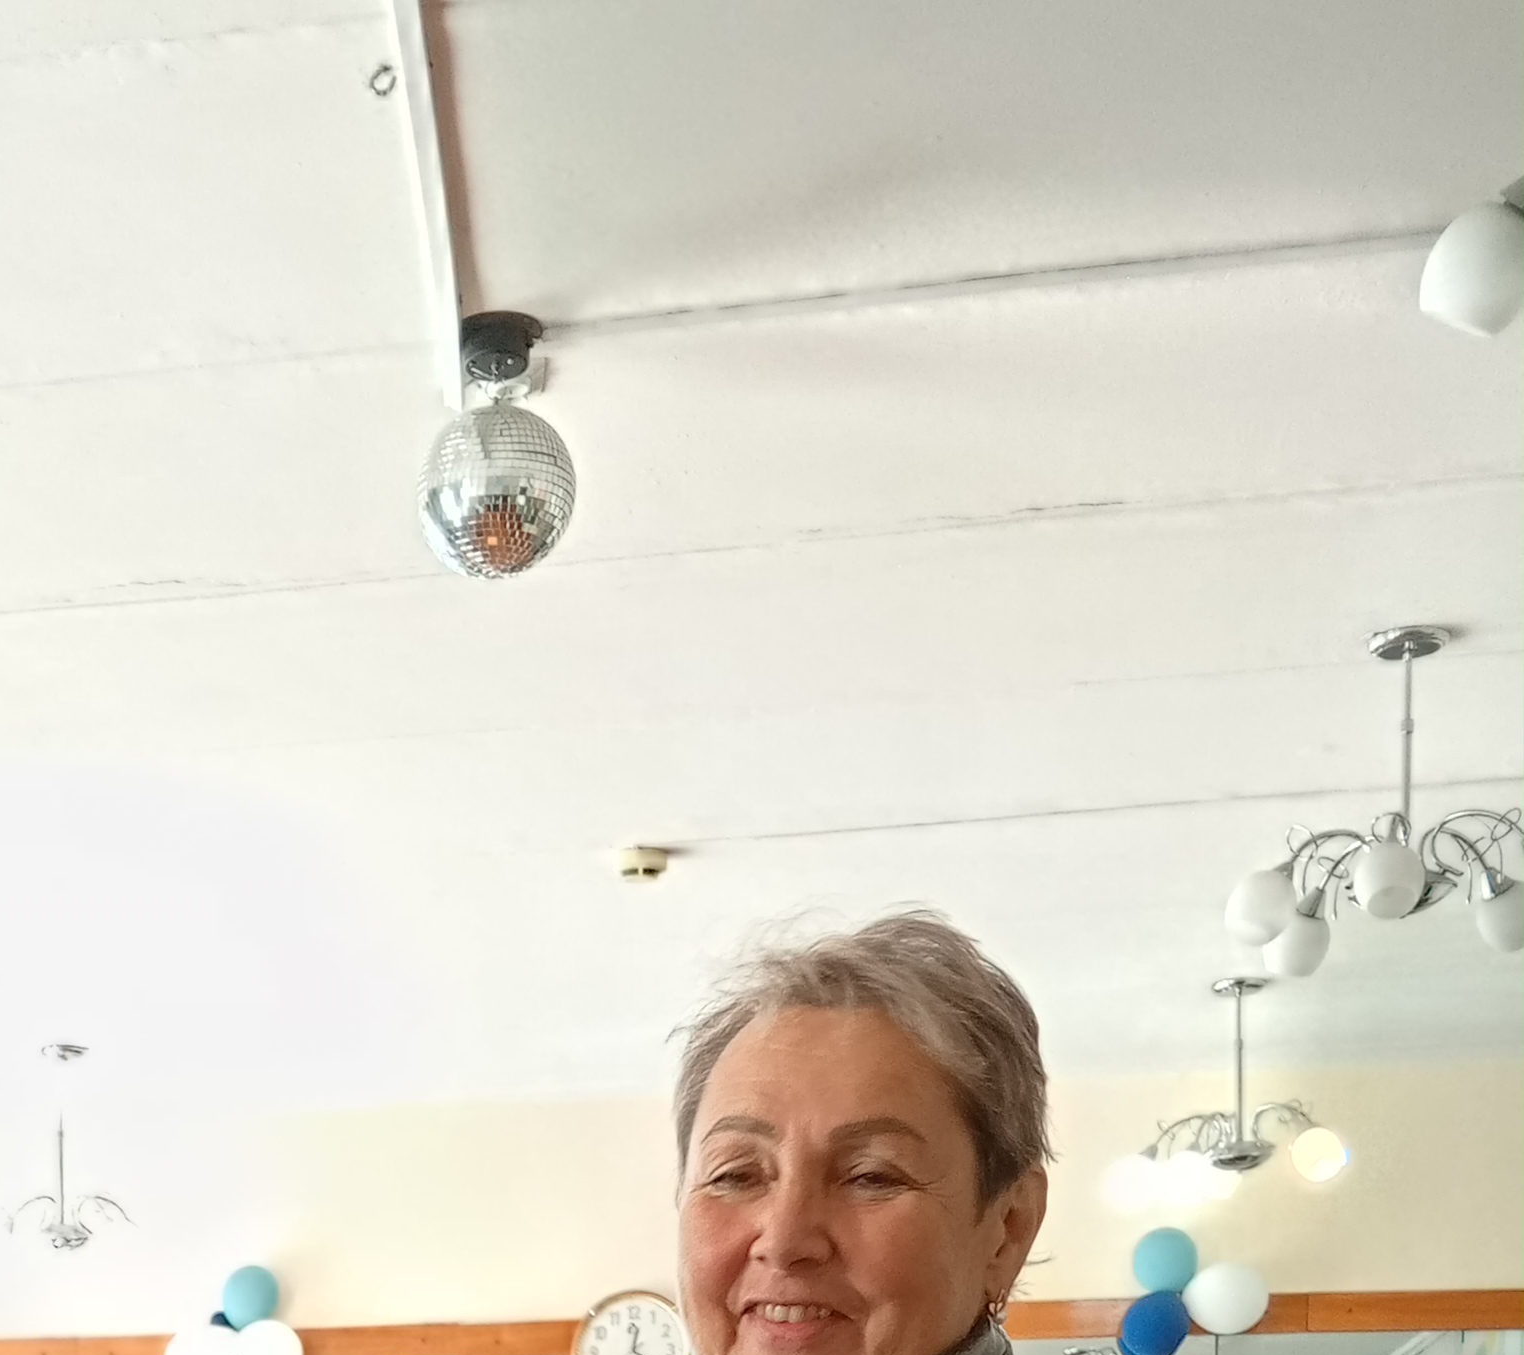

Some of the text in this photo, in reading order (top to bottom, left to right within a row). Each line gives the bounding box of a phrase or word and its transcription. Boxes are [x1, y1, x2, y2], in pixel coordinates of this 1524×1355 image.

[609, 1310, 620, 1326] 11
[627, 1305, 641, 1320] 12
[649, 1310, 657, 1324] 1
[594, 1325, 607, 1340] 10
[661, 1323, 670, 1338] 2
